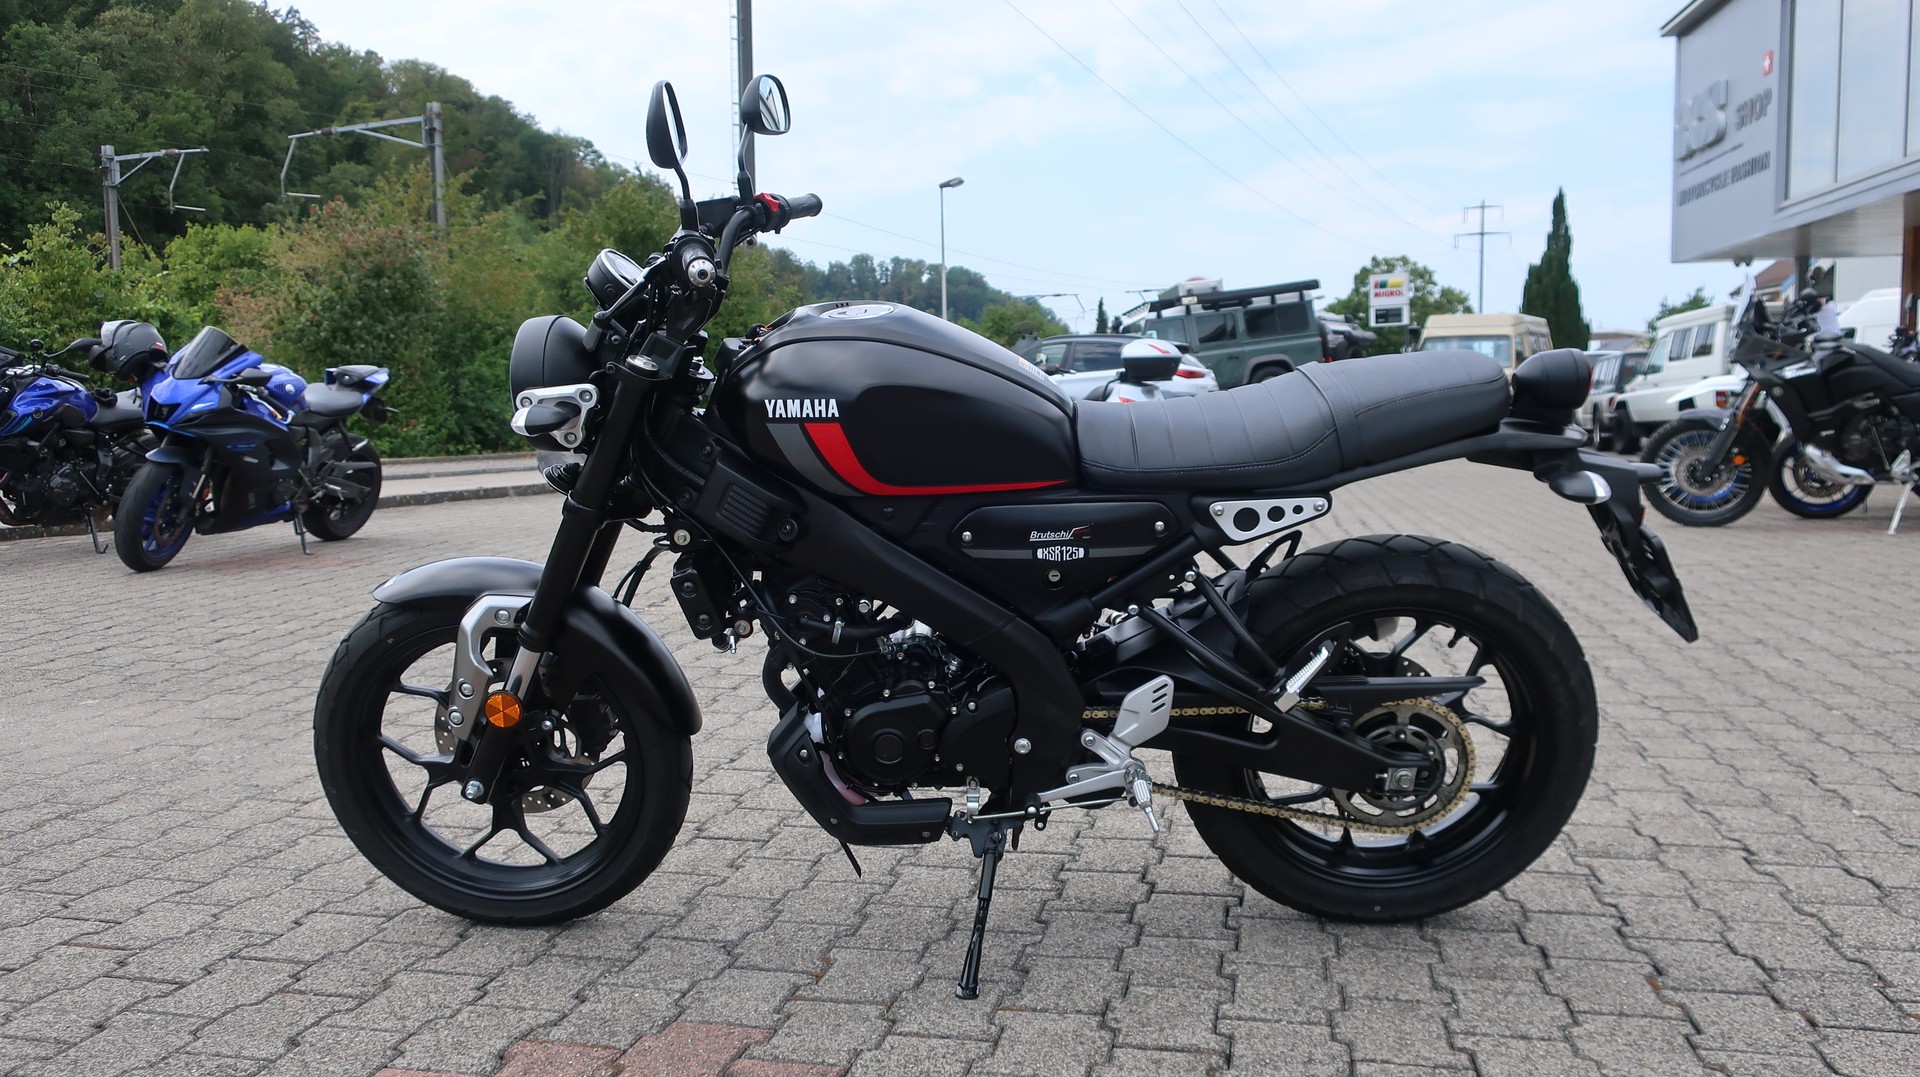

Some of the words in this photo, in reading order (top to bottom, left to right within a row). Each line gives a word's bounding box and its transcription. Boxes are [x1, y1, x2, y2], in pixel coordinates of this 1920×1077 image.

[1735, 87, 1773, 131] SHOP
[764, 399, 839, 418] YAMAHA
[1030, 530, 1069, 539] Brutschi
[1043, 546, 1079, 561] XSR125
